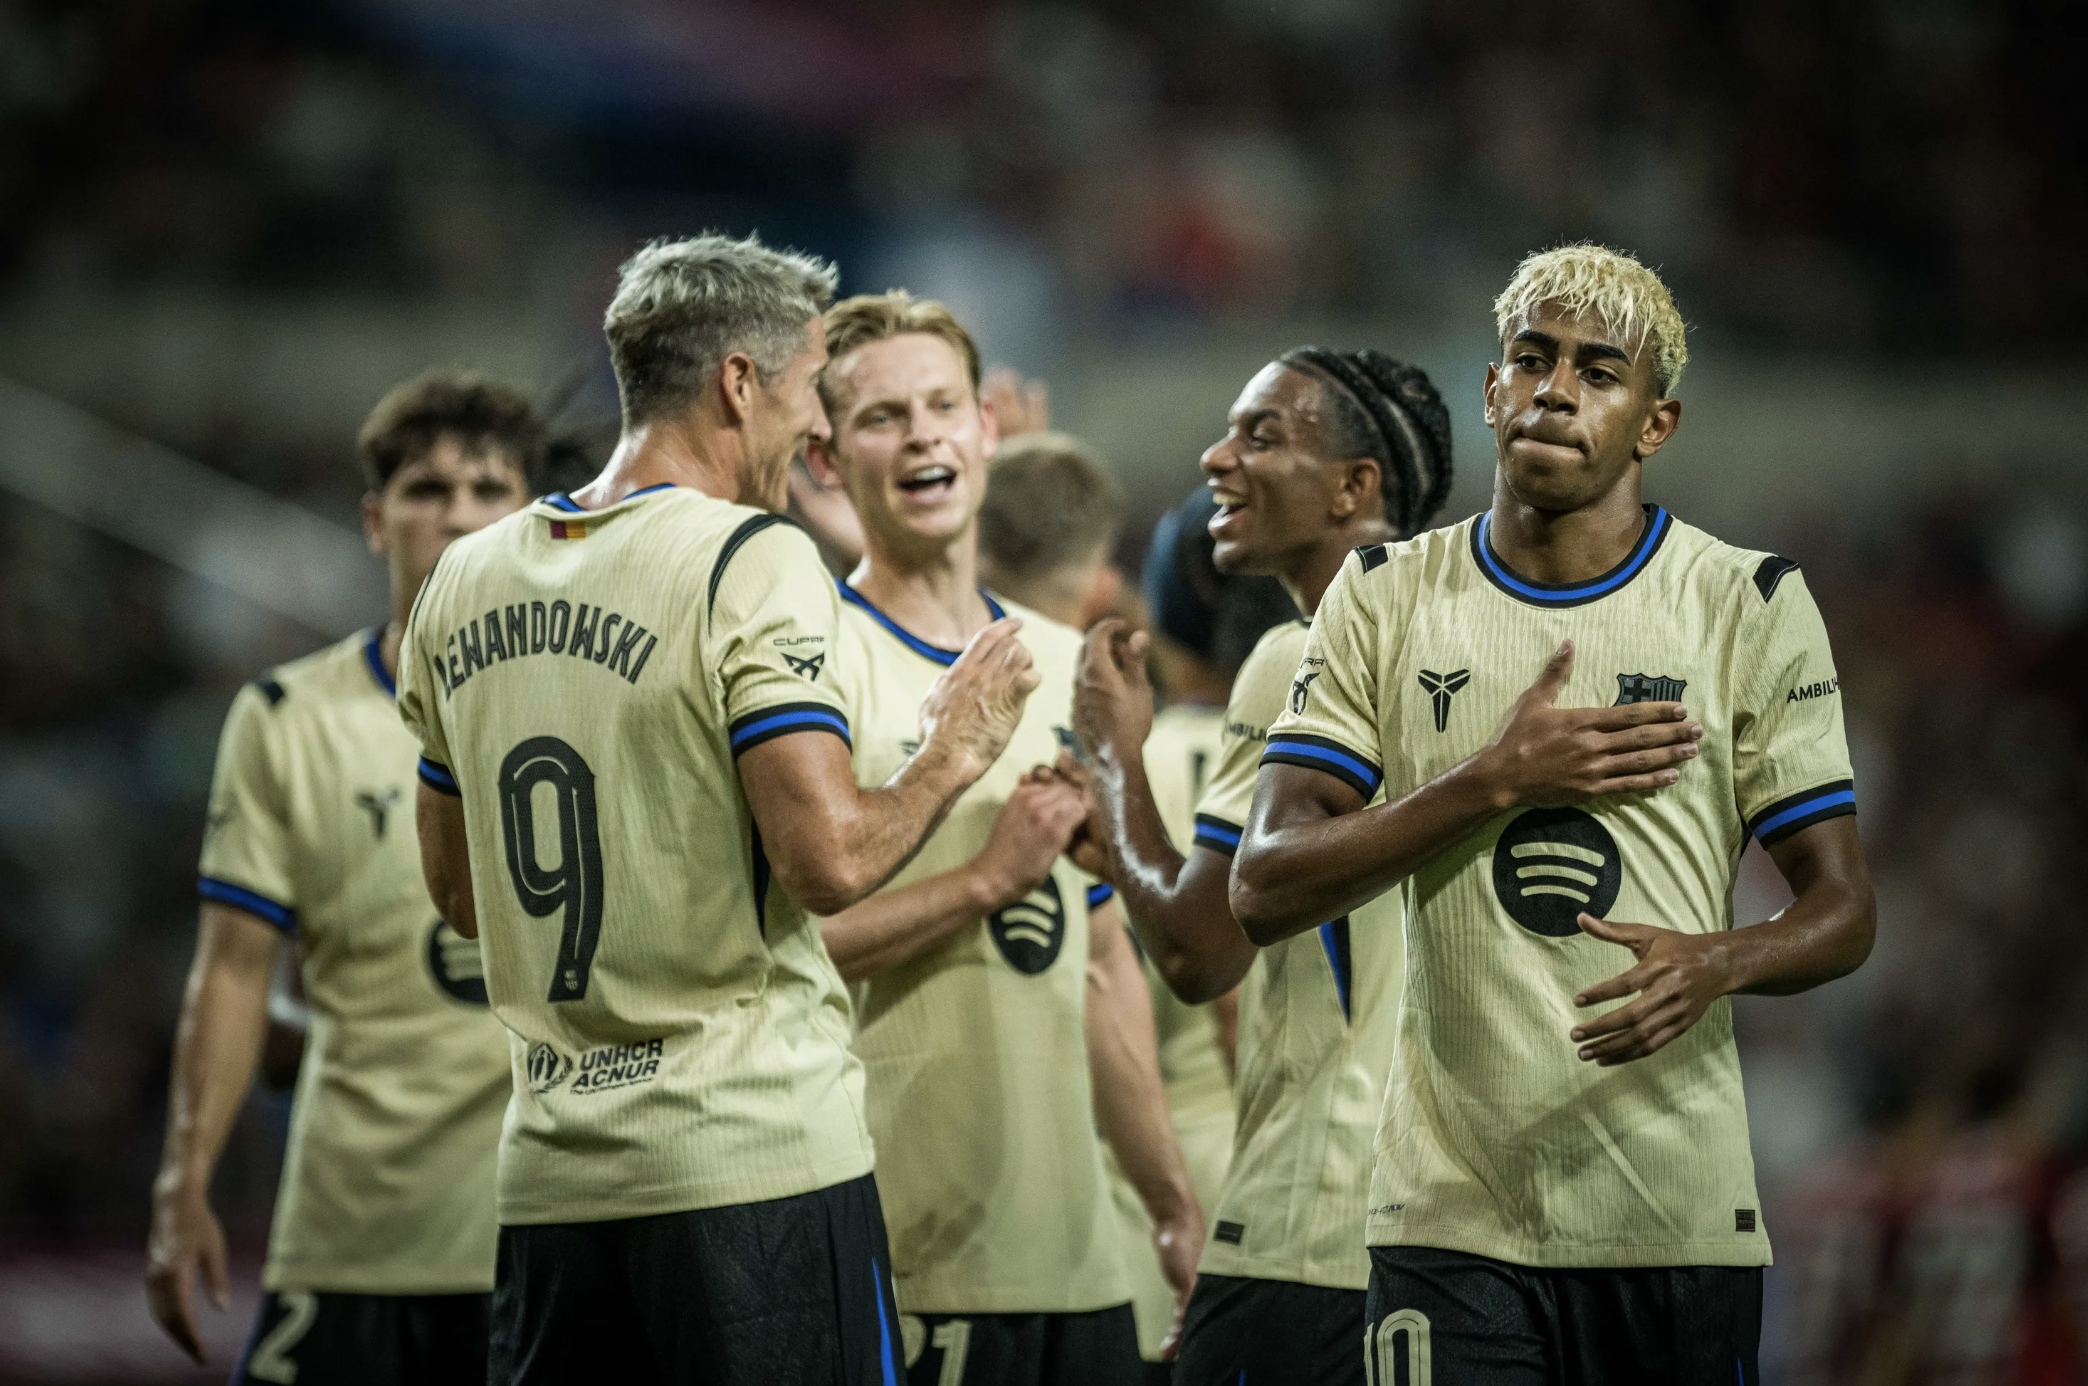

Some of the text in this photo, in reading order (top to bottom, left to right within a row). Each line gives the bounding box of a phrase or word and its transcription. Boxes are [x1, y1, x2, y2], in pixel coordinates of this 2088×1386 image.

[434, 600, 658, 702] LEWANDOWSKI
[498, 736, 604, 1003] 9
[571, 1059, 660, 1088] ACNUR
[580, 1038, 663, 1072] UNHCR
[249, 1291, 318, 1385] 2
